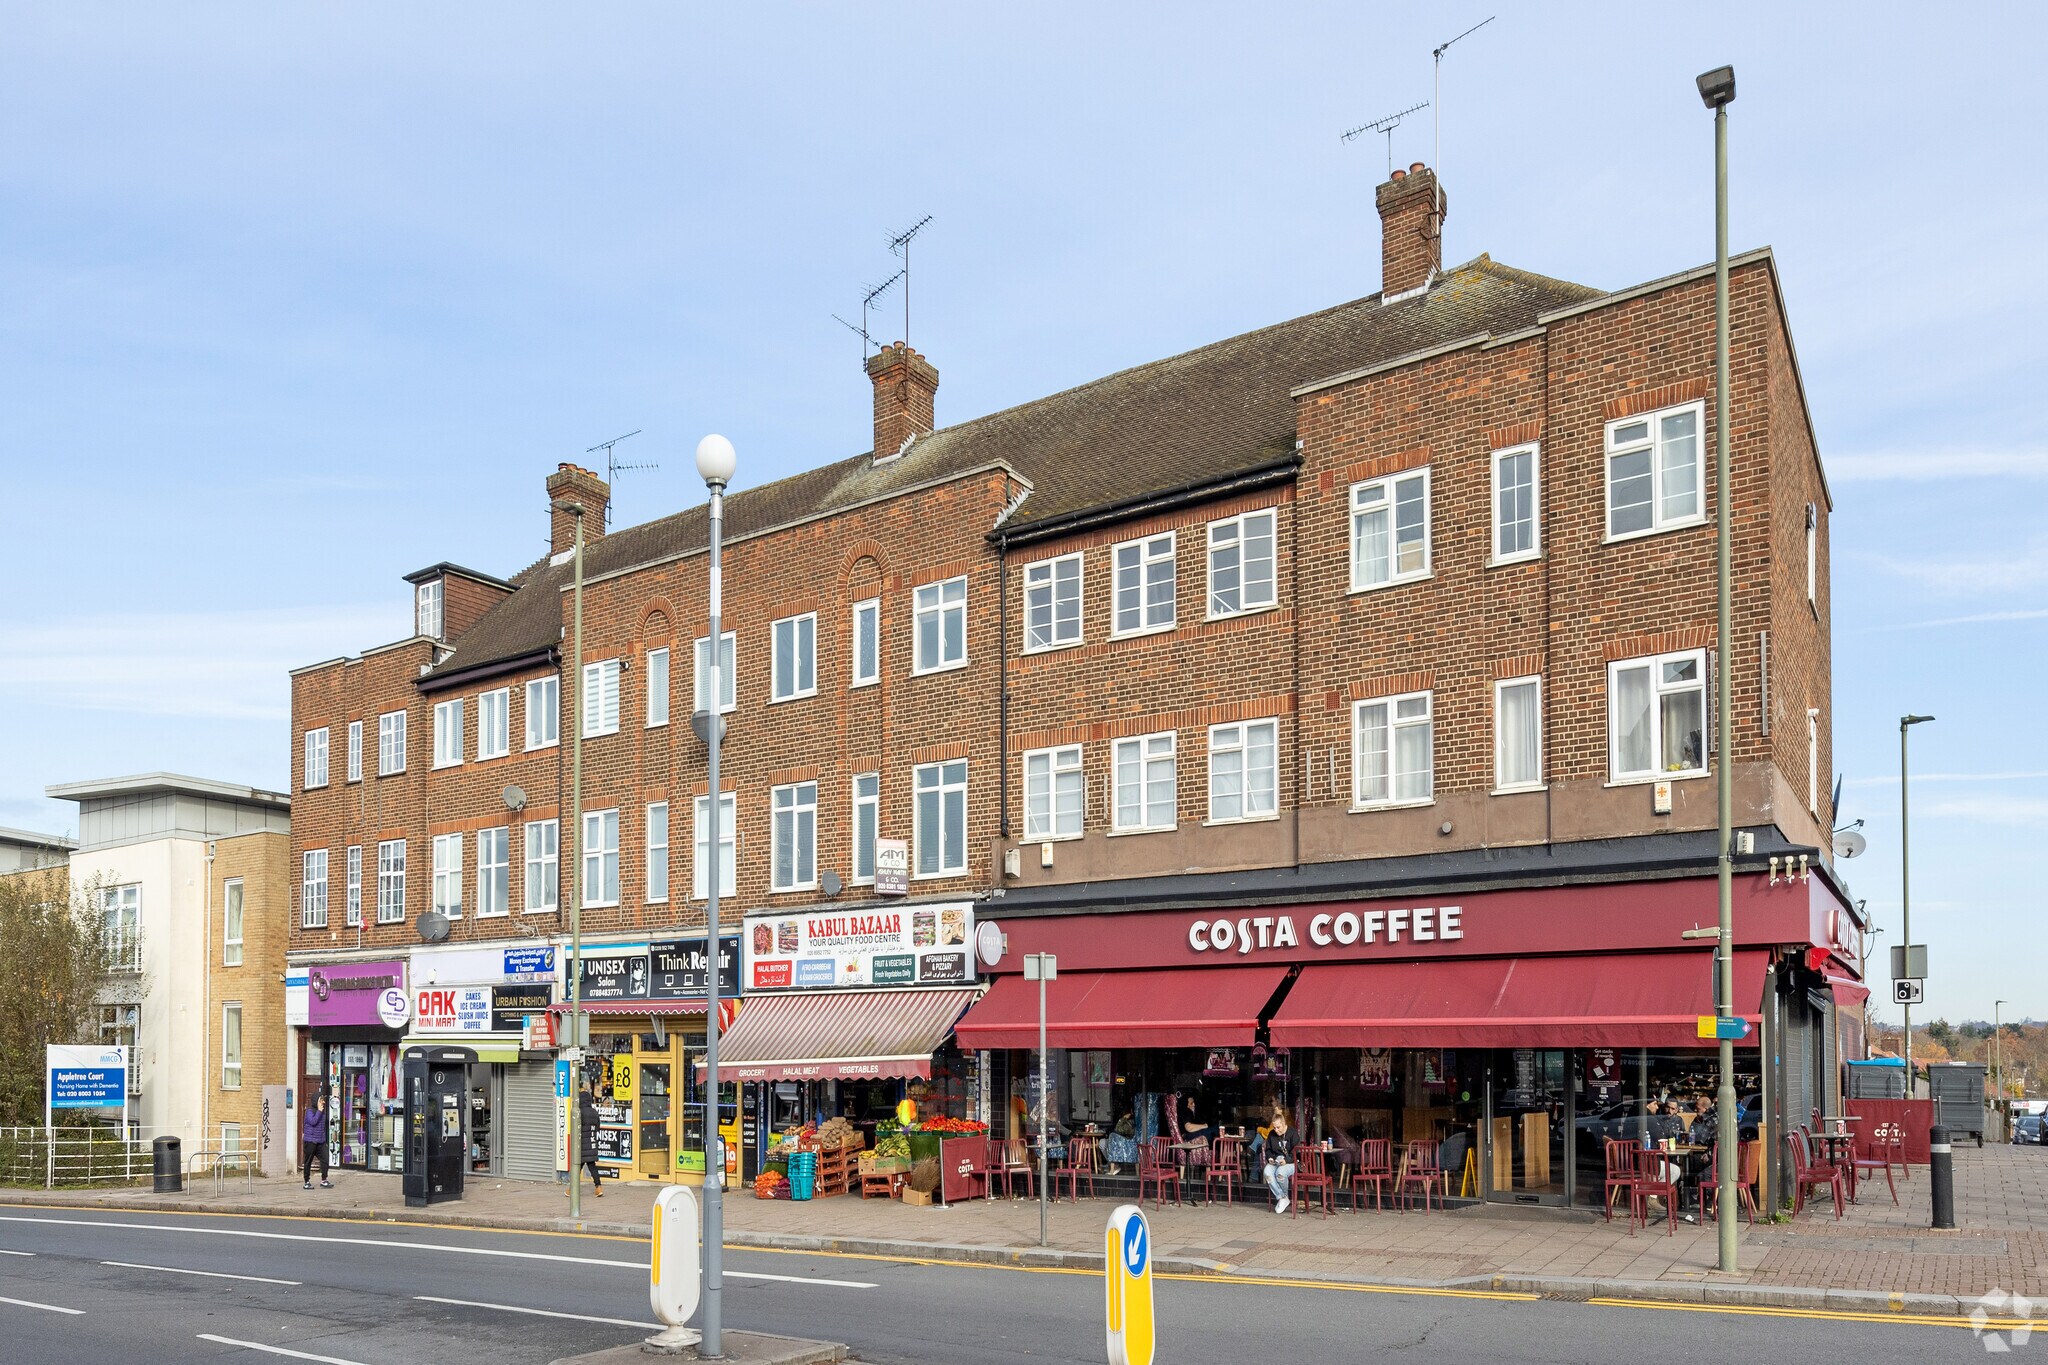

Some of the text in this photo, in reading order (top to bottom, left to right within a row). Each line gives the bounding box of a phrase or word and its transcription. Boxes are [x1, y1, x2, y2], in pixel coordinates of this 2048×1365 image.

[808, 914, 901, 938] KABUL BAZAAR
[1189, 906, 1464, 954] COSTA COFFEE
[809, 934, 900, 946] YOUR QUALITY FOOD CENTRE
[983, 936, 1000, 946] COSTA
[659, 950, 730, 972] Think Reir
[889, 958, 912, 967] VEGETABLES
[943, 954, 959, 962] BAKERY
[588, 959, 626, 976] UNISEX
[770, 964, 788, 972] BUTCHER
[598, 976, 616, 987] Salon
[465, 992, 481, 1000] CAKES
[419, 991, 456, 1015] OAK
[460, 1002, 486, 1010] ICE CREAM
[495, 997, 518, 1006] URBAN
[458, 1012, 489, 1020] SLUSH JUICE
[418, 1017, 456, 1027] MINI MART
[464, 1021, 481, 1029] COFFEE
[738, 1065, 879, 1077] GROCERY HALAL MEAT VEGETABLES
[57, 1072, 104, 1083] Appletree Court
[616, 1067, 631, 1088] £8
[596, 1130, 617, 1142] NISEX
[598, 1141, 610, 1149] Salon
[958, 1164, 974, 1173] COSTA
